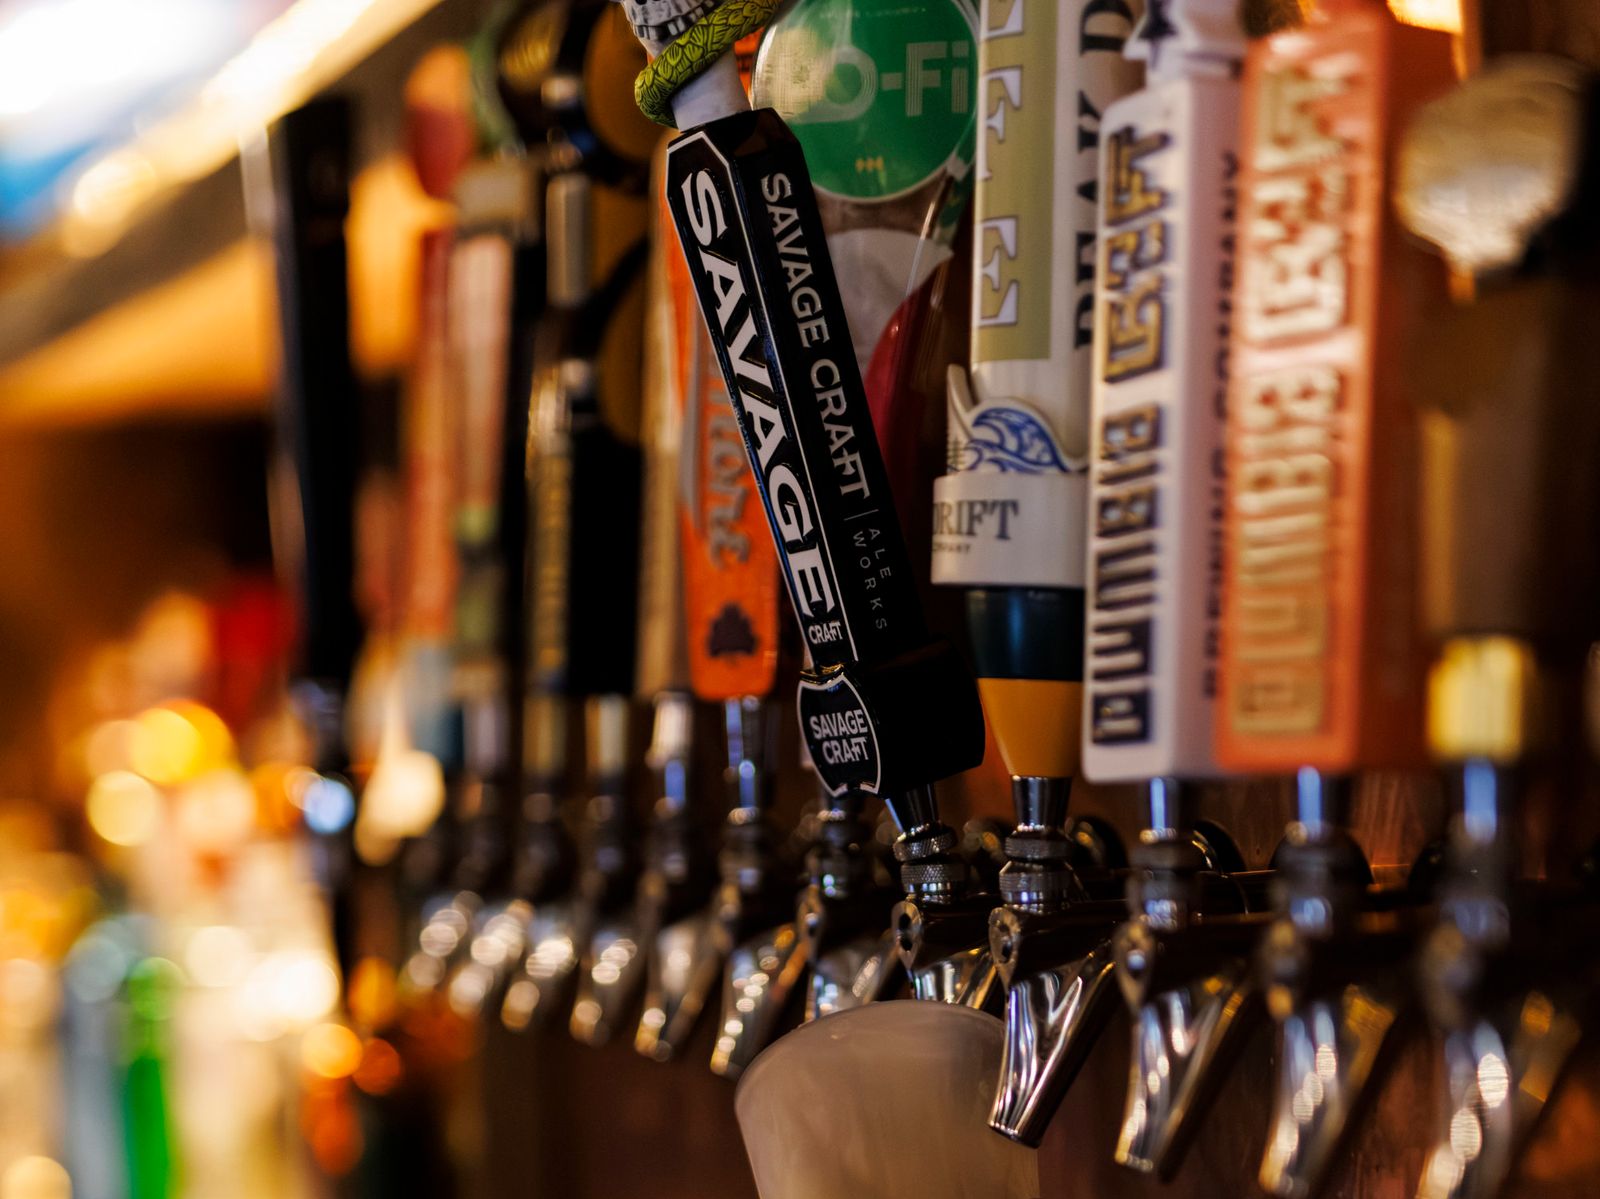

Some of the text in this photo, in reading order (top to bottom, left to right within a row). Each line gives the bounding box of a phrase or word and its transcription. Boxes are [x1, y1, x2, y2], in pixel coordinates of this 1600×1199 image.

[762, 173, 870, 499] SAVAGE CRAFT
[681, 169, 834, 617] SAVAGE
[808, 621, 842, 645] CRAFT
[854, 531, 888, 629] WORKS
[869, 528, 892, 579] ALE
[809, 708, 868, 740] SAVAGE
[822, 736, 869, 765] CRAFT
